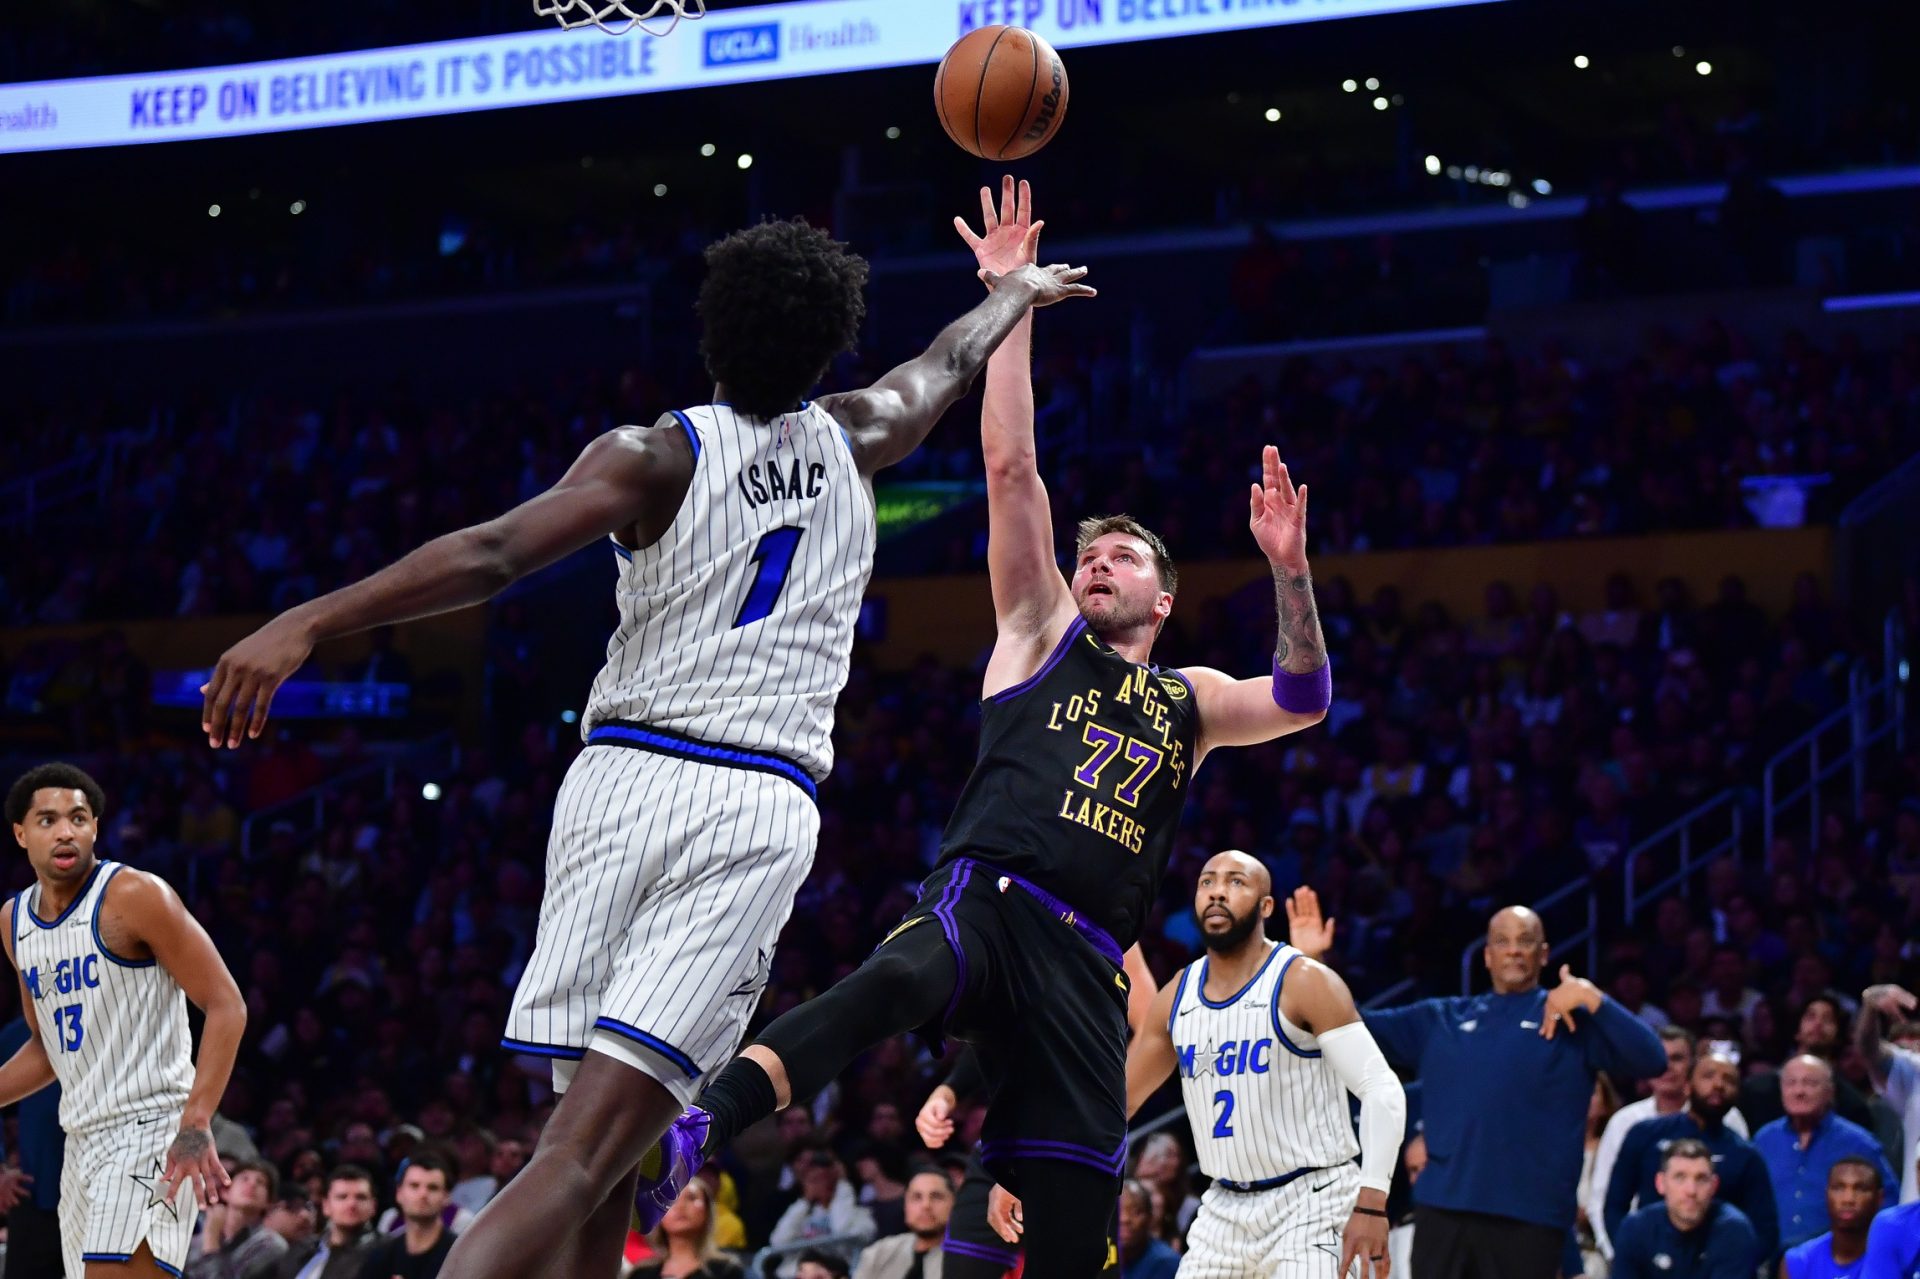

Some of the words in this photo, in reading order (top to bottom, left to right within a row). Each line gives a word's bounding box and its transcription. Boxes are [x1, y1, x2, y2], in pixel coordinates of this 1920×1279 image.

[709, 28, 775, 62] UCLA
[788, 16, 880, 53] Health
[957, 0, 1043, 38] KEEP
[130, 84, 208, 129] KEEP
[217, 80, 260, 121] ON
[268, 59, 427, 117] BELIEVING
[435, 52, 493, 98] IT'S
[503, 35, 656, 90] POSSIBLE
[738, 459, 825, 509] ISAAC
[731, 525, 806, 630] 1
[1046, 688, 1102, 732] LOS
[1115, 665, 1185, 790] ANGELES
[1073, 720, 1165, 808] 77
[1058, 788, 1146, 855] LAKERS
[54, 1003, 84, 1054] 13
[1211, 1089, 1235, 1139] 2
